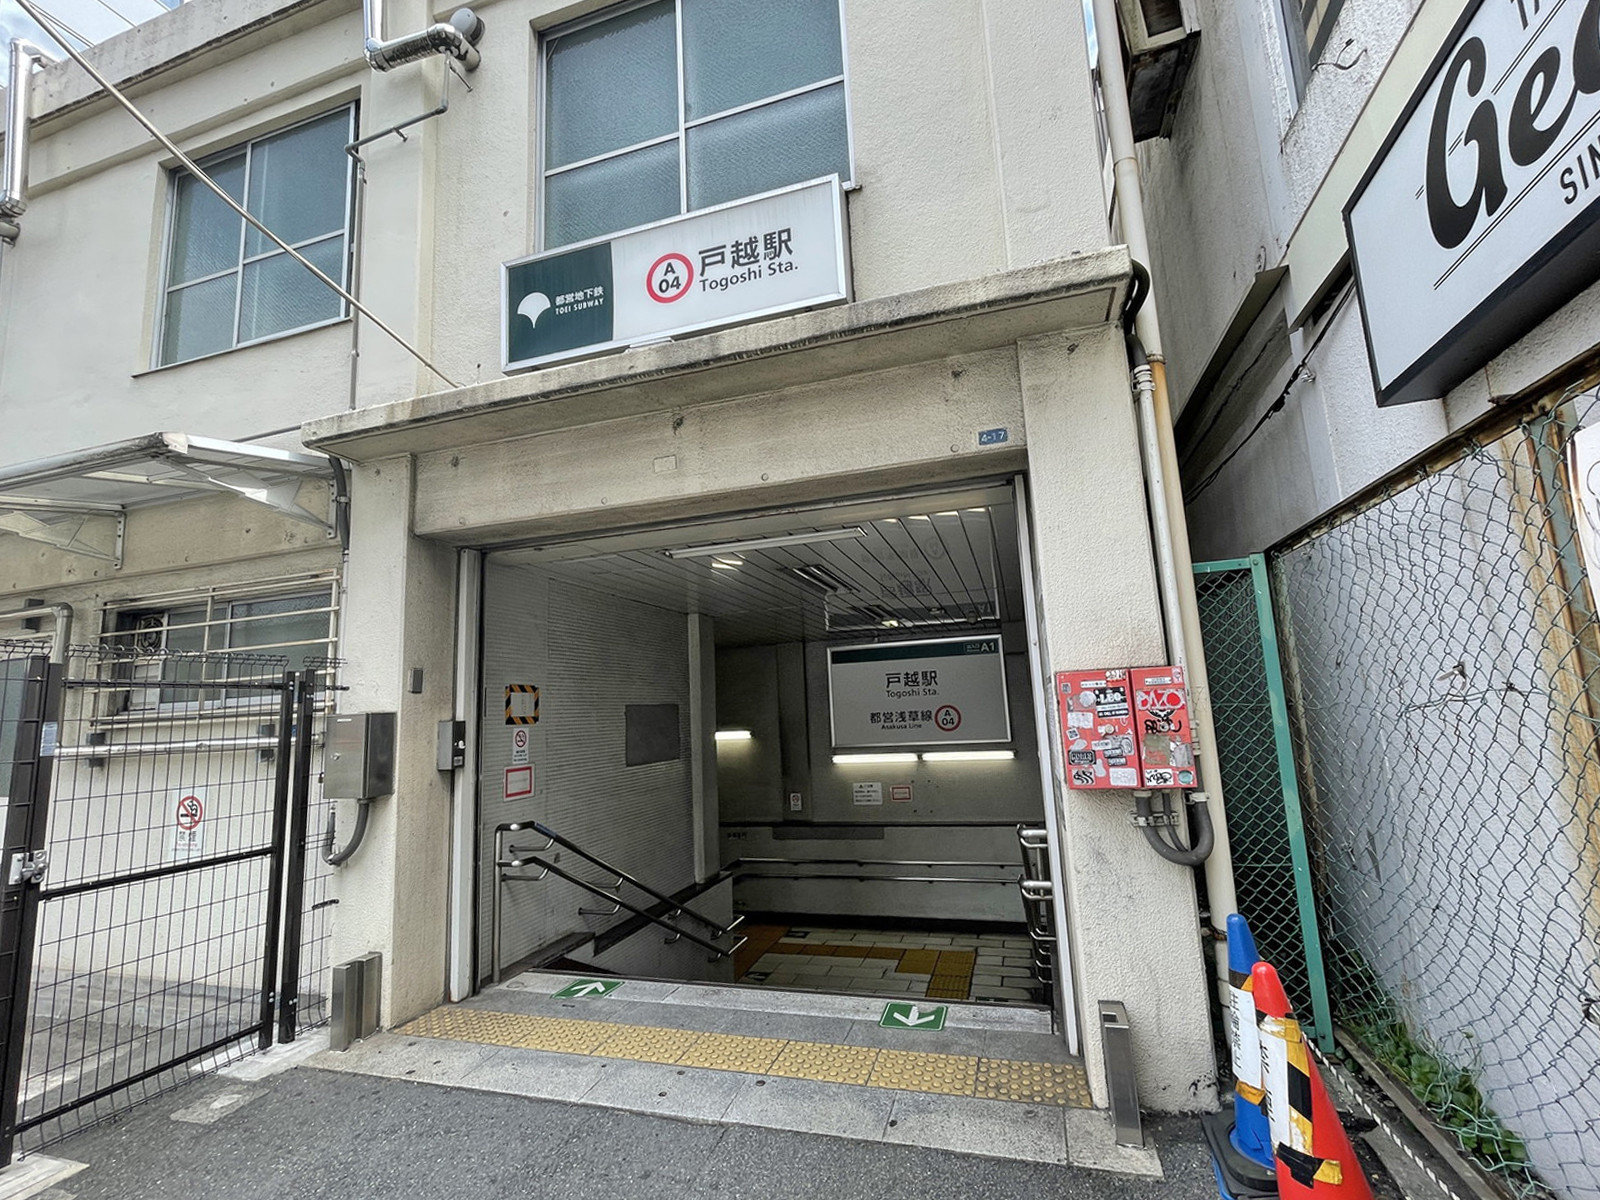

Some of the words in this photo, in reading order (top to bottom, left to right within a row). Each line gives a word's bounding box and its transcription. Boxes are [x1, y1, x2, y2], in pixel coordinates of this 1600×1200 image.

[698, 227, 794, 278] 戸越駅
[663, 261, 676, 277] A
[699, 265, 762, 292] Togoshi
[768, 260, 799, 276] Sta.
[658, 276, 682, 294] 04
[555, 305, 572, 315] TOEI
[573, 297, 604, 311] SUBWAY
[980, 641, 995, 652] A1
[885, 670, 938, 688] 戸越駅
[886, 688, 920, 699] Togoshi
[922, 688, 940, 696] Sta.
[870, 709, 933, 724] 都営浅草線
[944, 709, 951, 717] A
[941, 717, 955, 726] 04
